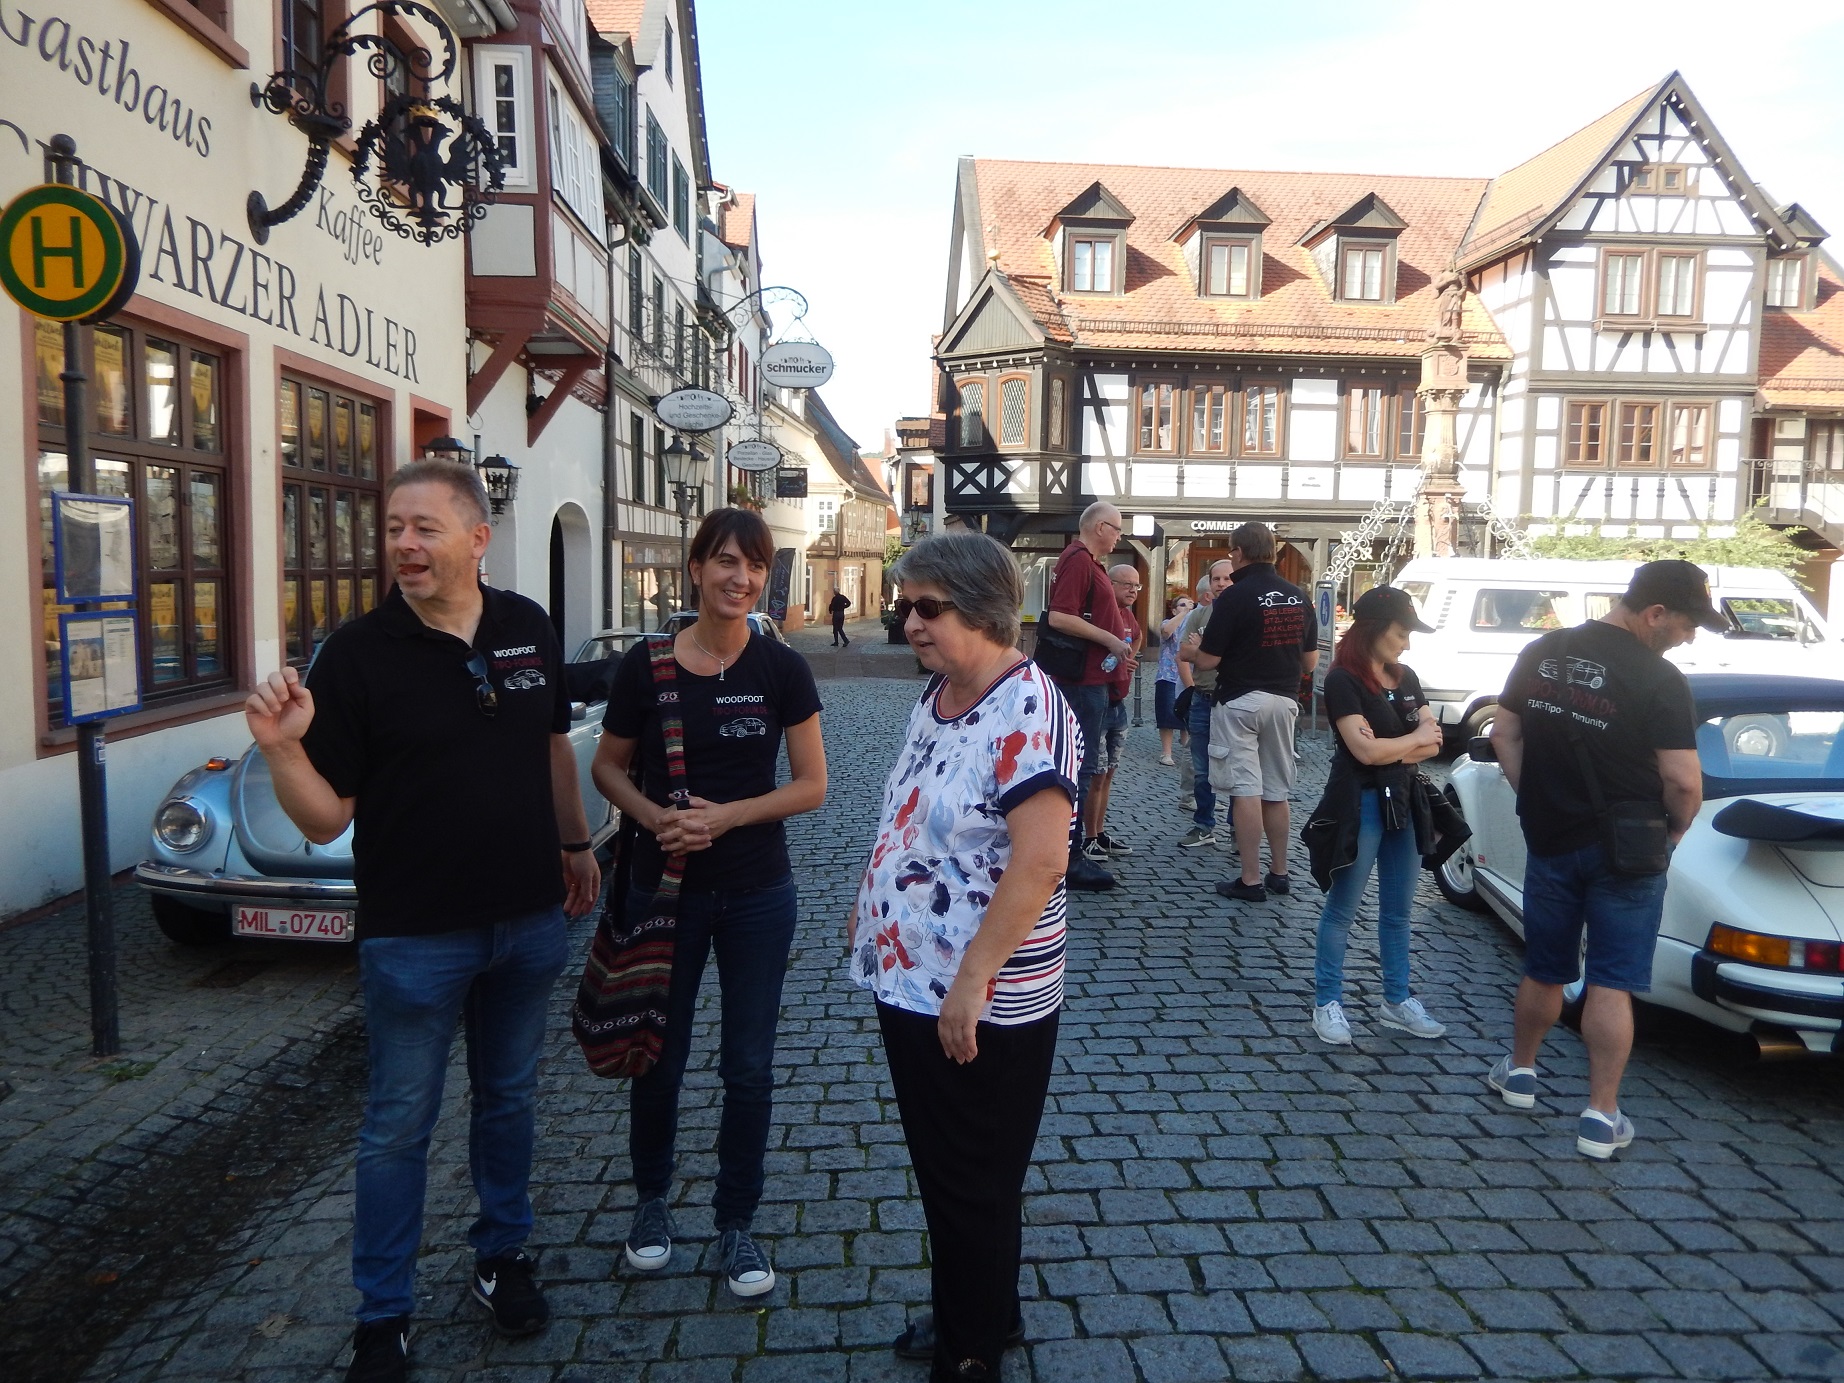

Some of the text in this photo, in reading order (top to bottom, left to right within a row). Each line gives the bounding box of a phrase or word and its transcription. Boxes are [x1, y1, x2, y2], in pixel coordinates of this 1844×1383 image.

[316, 183, 384, 266] Kaffee
[30, 216, 85, 288] H
[309, 282, 420, 385] ADLER
[766, 363, 827, 374] Schmucker
[493, 645, 537, 658] WOODFOOT
[715, 695, 765, 705] WOODFOOT
